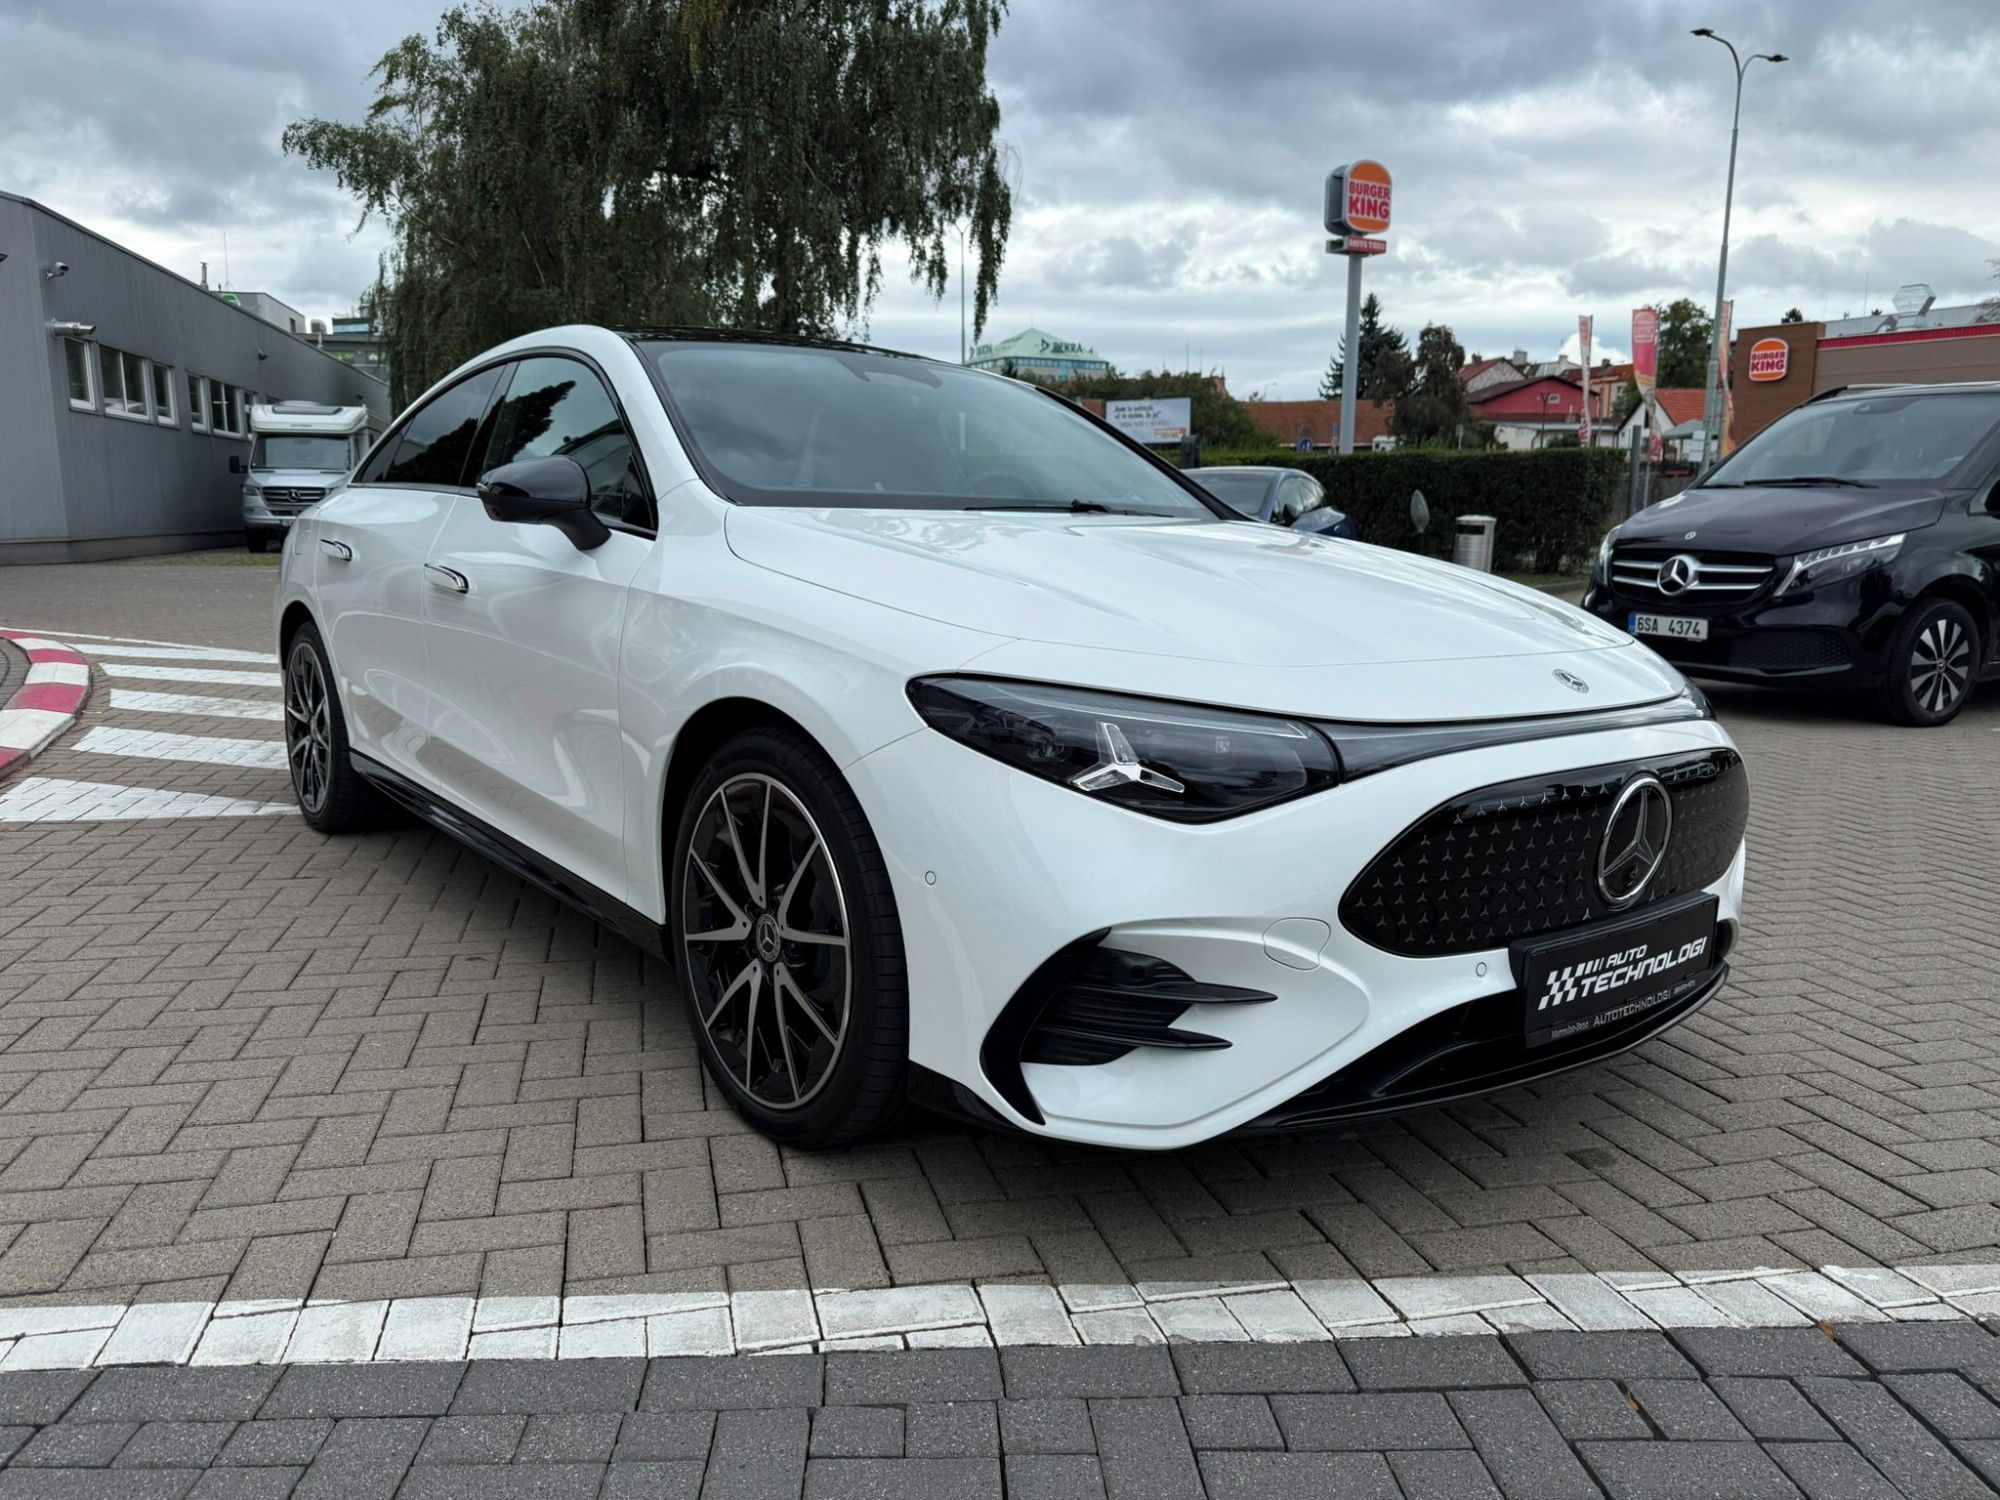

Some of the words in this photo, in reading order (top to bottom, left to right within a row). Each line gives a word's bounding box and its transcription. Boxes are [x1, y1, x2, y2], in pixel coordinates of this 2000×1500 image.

[1349, 181, 1390, 200] BURGER
[1348, 196, 1389, 219] KING
[1751, 359, 1785, 372] KING
[1752, 351, 1785, 361] BURGER
[1637, 616, 1658, 633] 6SA
[1668, 619, 1701, 637] 4374
[1580, 936, 1708, 998] TECHNOLOGI
[1606, 943, 1648, 969] AUTO
[1593, 988, 1671, 1027] AUTOTECHNOLOGI
